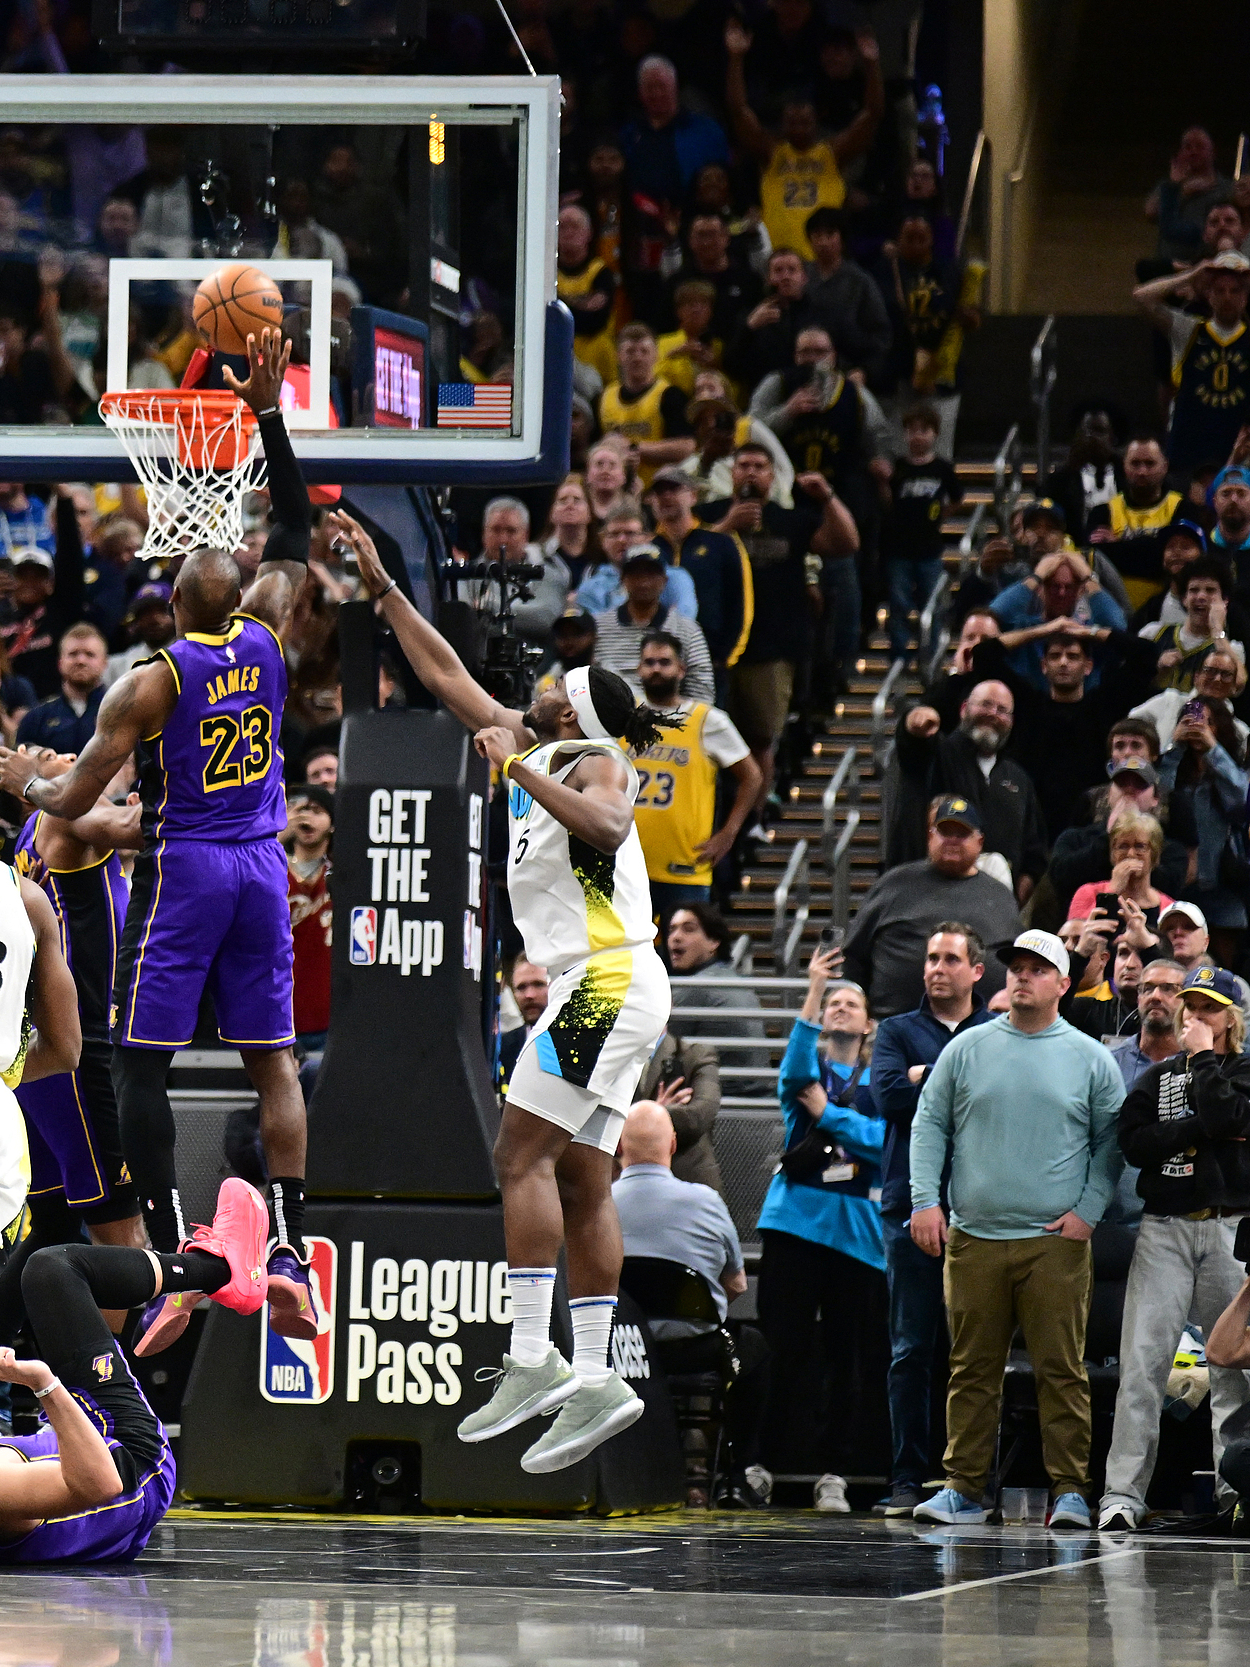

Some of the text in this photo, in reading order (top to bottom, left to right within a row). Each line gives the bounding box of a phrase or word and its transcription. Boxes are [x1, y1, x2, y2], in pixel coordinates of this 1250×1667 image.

[206, 666, 261, 705] JAMES
[200, 704, 273, 794] 23
[368, 788, 432, 844] GET
[634, 768, 676, 808] 23
[367, 847, 432, 903] THE
[379, 907, 444, 976] App
[349, 1241, 515, 1338] League
[271, 1364, 306, 1392] NBA
[347, 1323, 463, 1405] Pass
